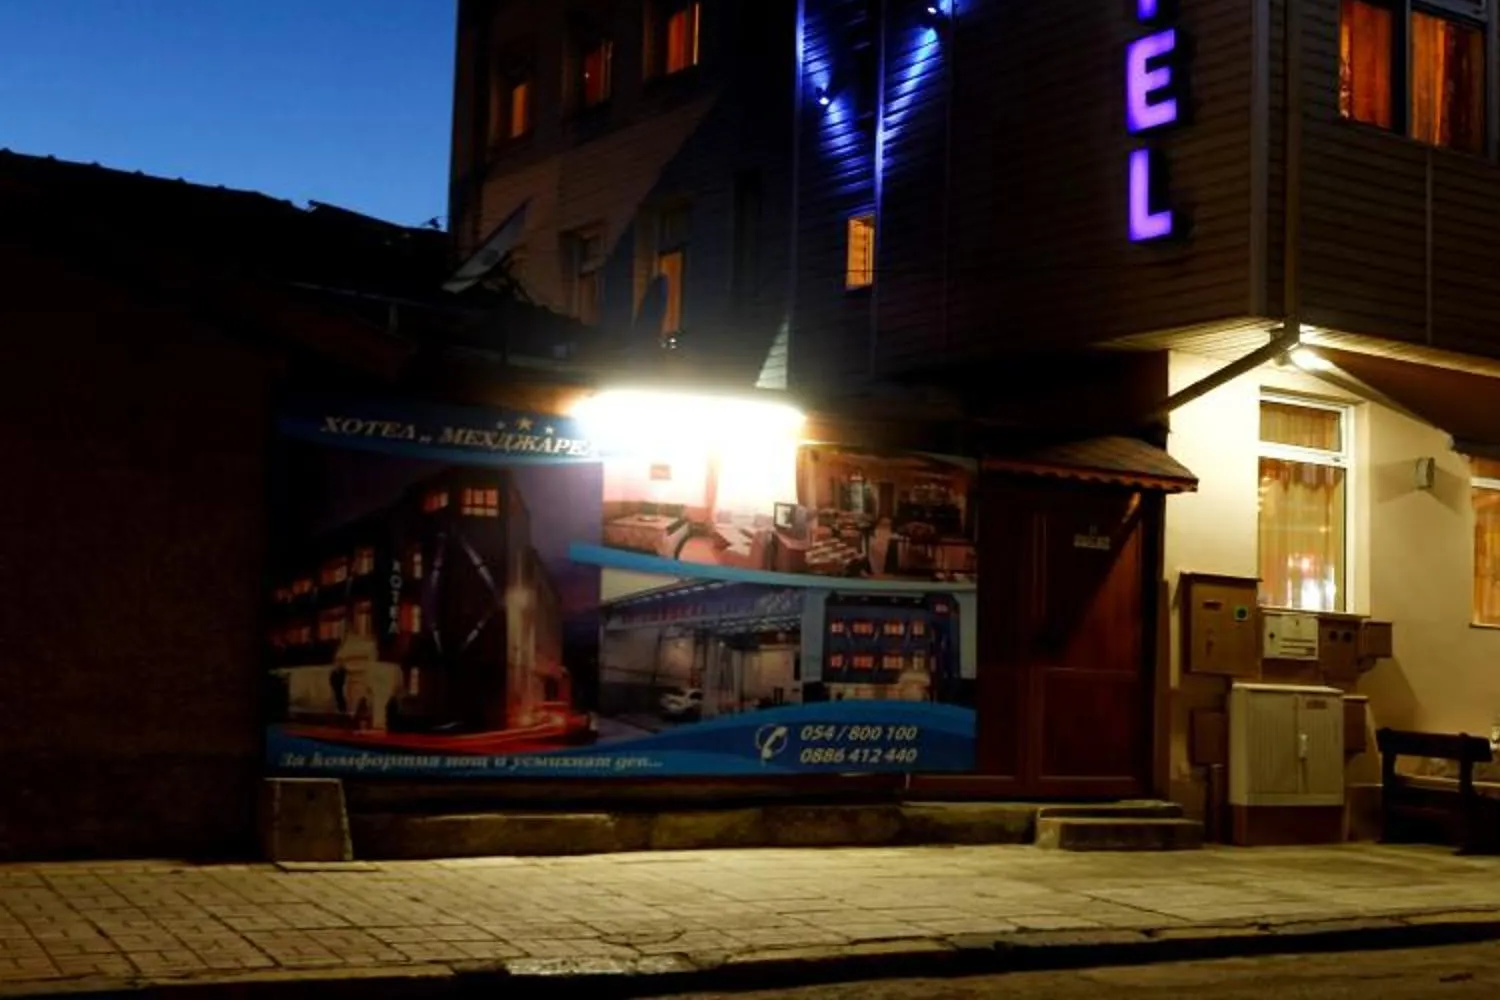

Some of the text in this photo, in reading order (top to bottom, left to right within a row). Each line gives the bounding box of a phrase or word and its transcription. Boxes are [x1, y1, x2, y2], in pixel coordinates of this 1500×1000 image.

[320, 416, 415, 440] ХОТЕЛ
[886, 725, 918, 741] 100
[848, 747, 883, 764] 412
